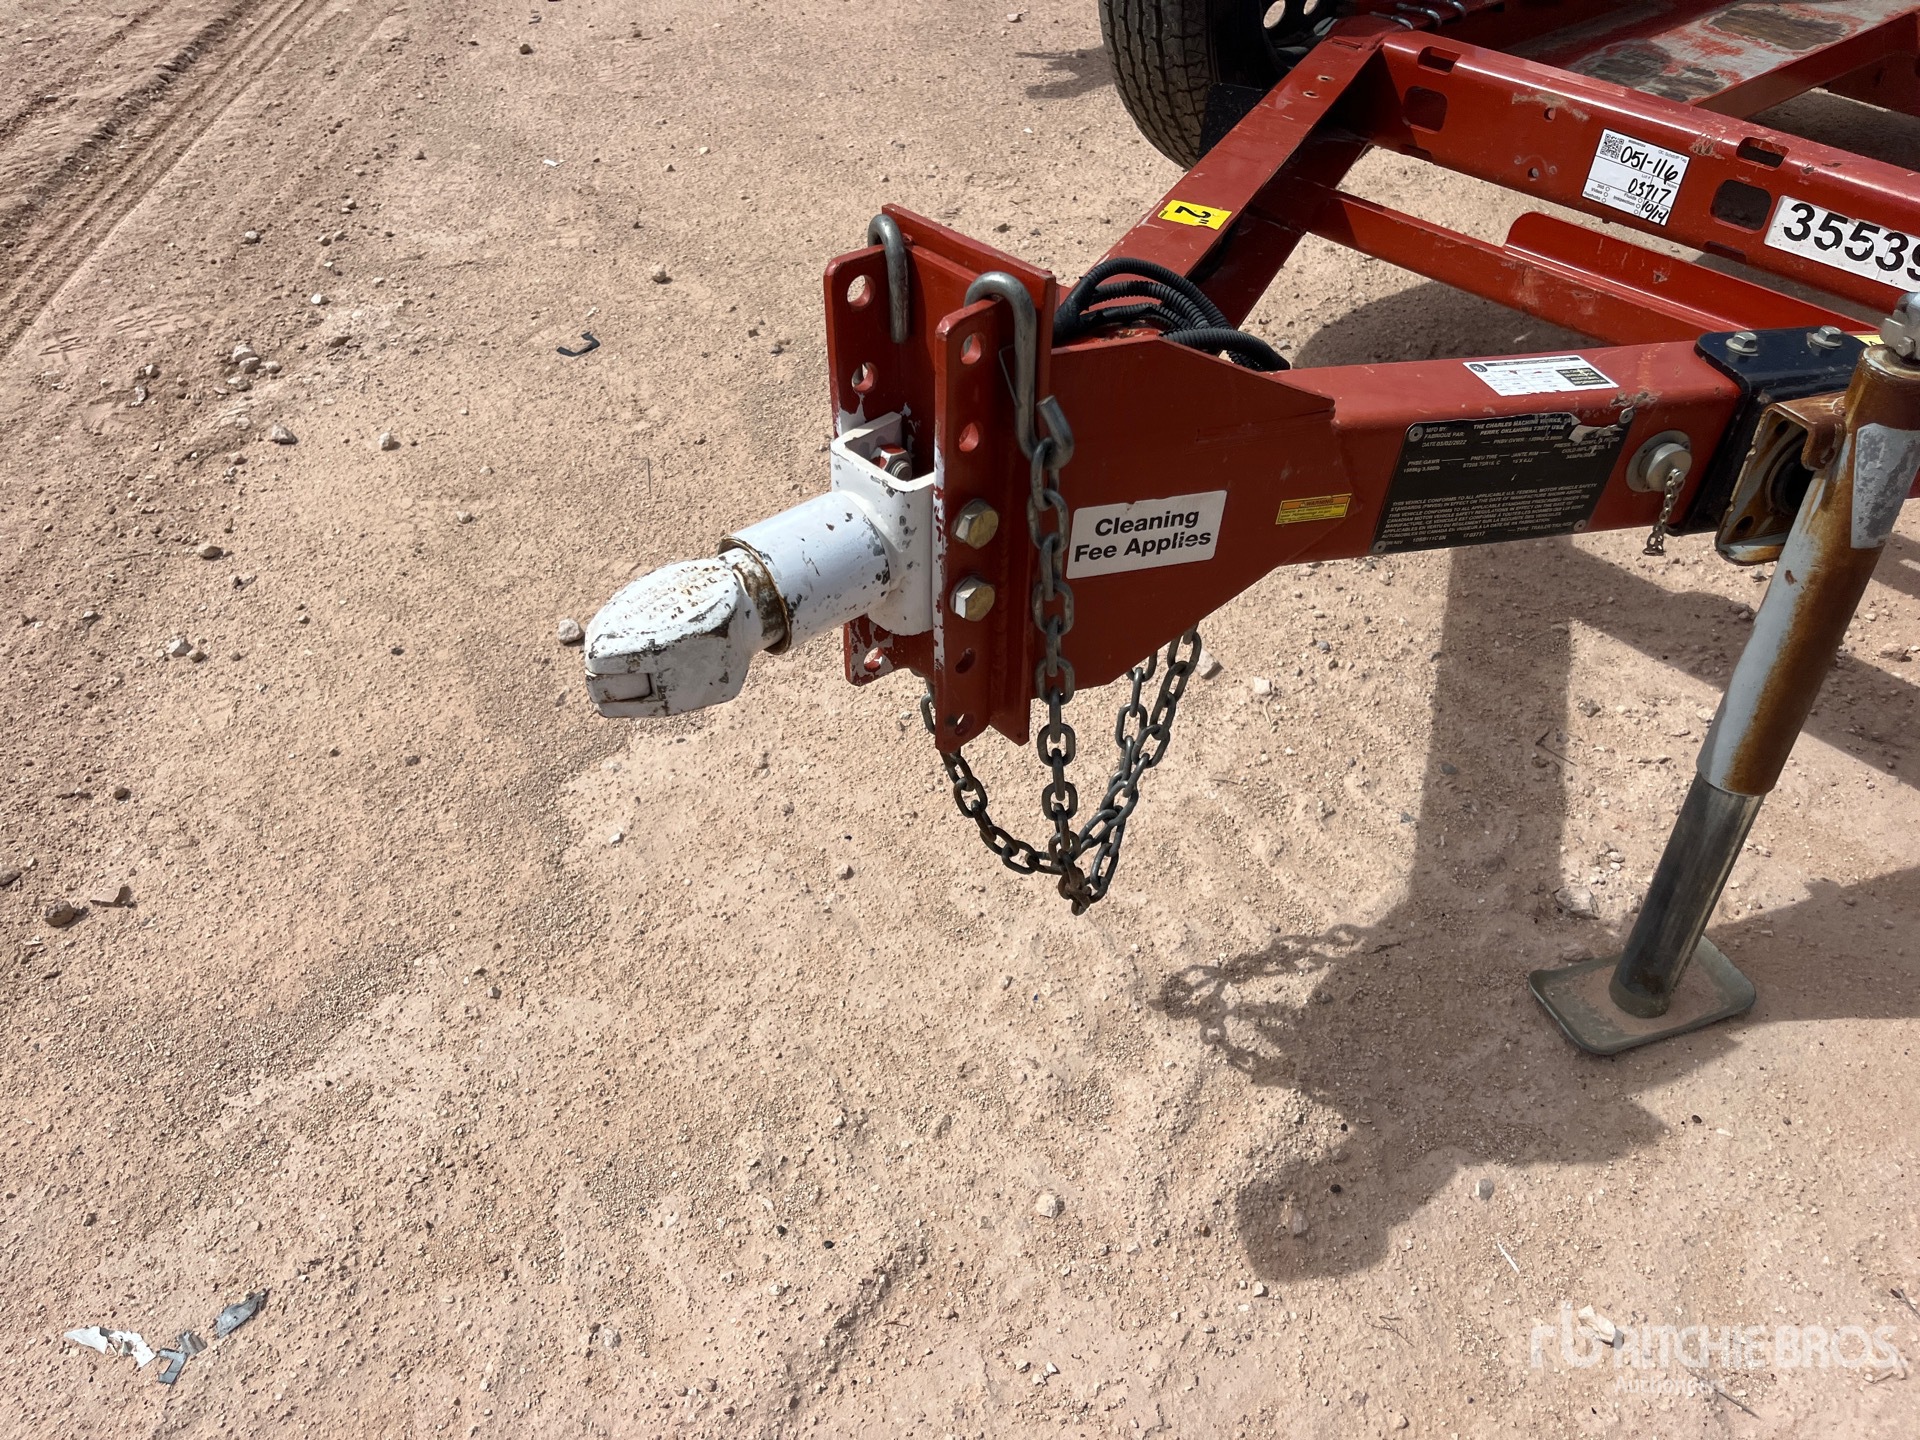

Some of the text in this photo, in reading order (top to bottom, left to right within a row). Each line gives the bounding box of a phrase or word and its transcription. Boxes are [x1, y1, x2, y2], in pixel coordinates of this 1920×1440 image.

[1620, 146, 1678, 184] 051-116
[1628, 178, 1671, 204] 03717
[1095, 511, 1199, 537] Cleaning
[1074, 532, 1211, 562] Fee Applies
